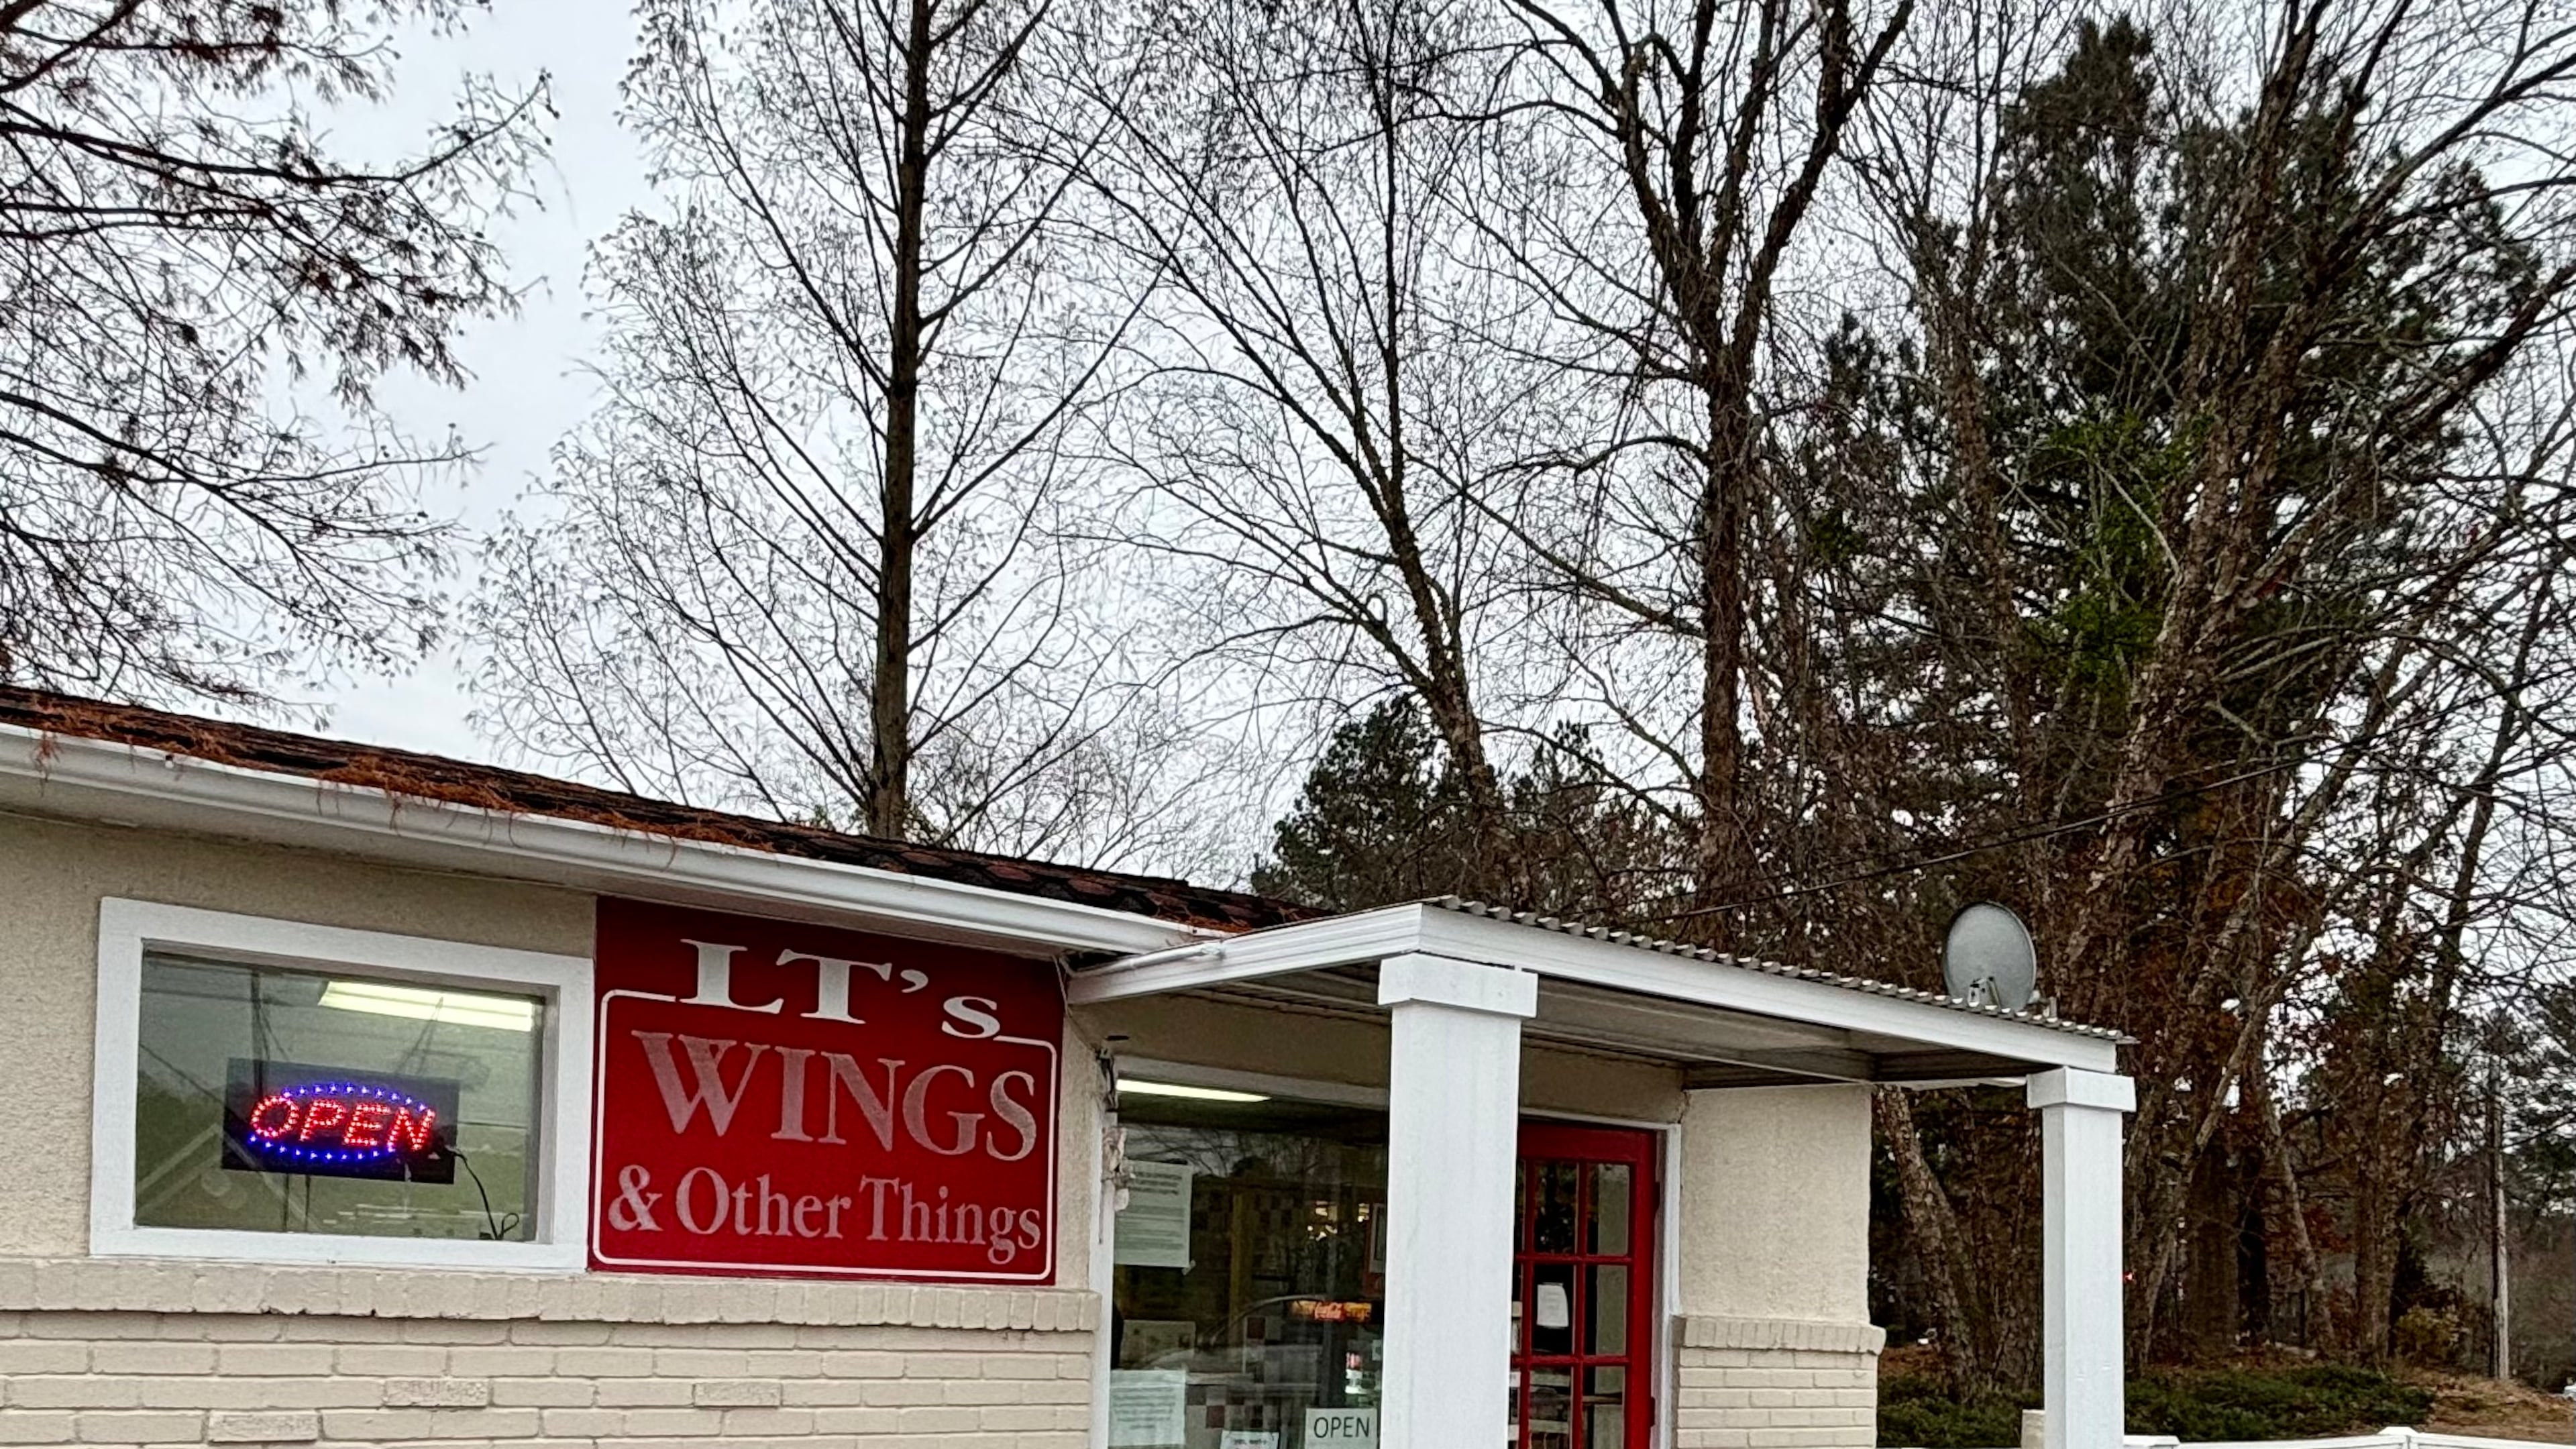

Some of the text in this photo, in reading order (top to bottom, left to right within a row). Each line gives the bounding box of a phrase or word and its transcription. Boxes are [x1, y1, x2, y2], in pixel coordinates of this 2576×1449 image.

[680, 939, 1001, 1038] LT's
[251, 1095, 435, 1152] OPEN
[632, 1030, 1037, 1161] WINGS
[609, 1165, 662, 1230] &
[676, 1167, 851, 1238] Other
[860, 1175, 1040, 1265] Things
[1313, 1416, 1370, 1438] OPEN
